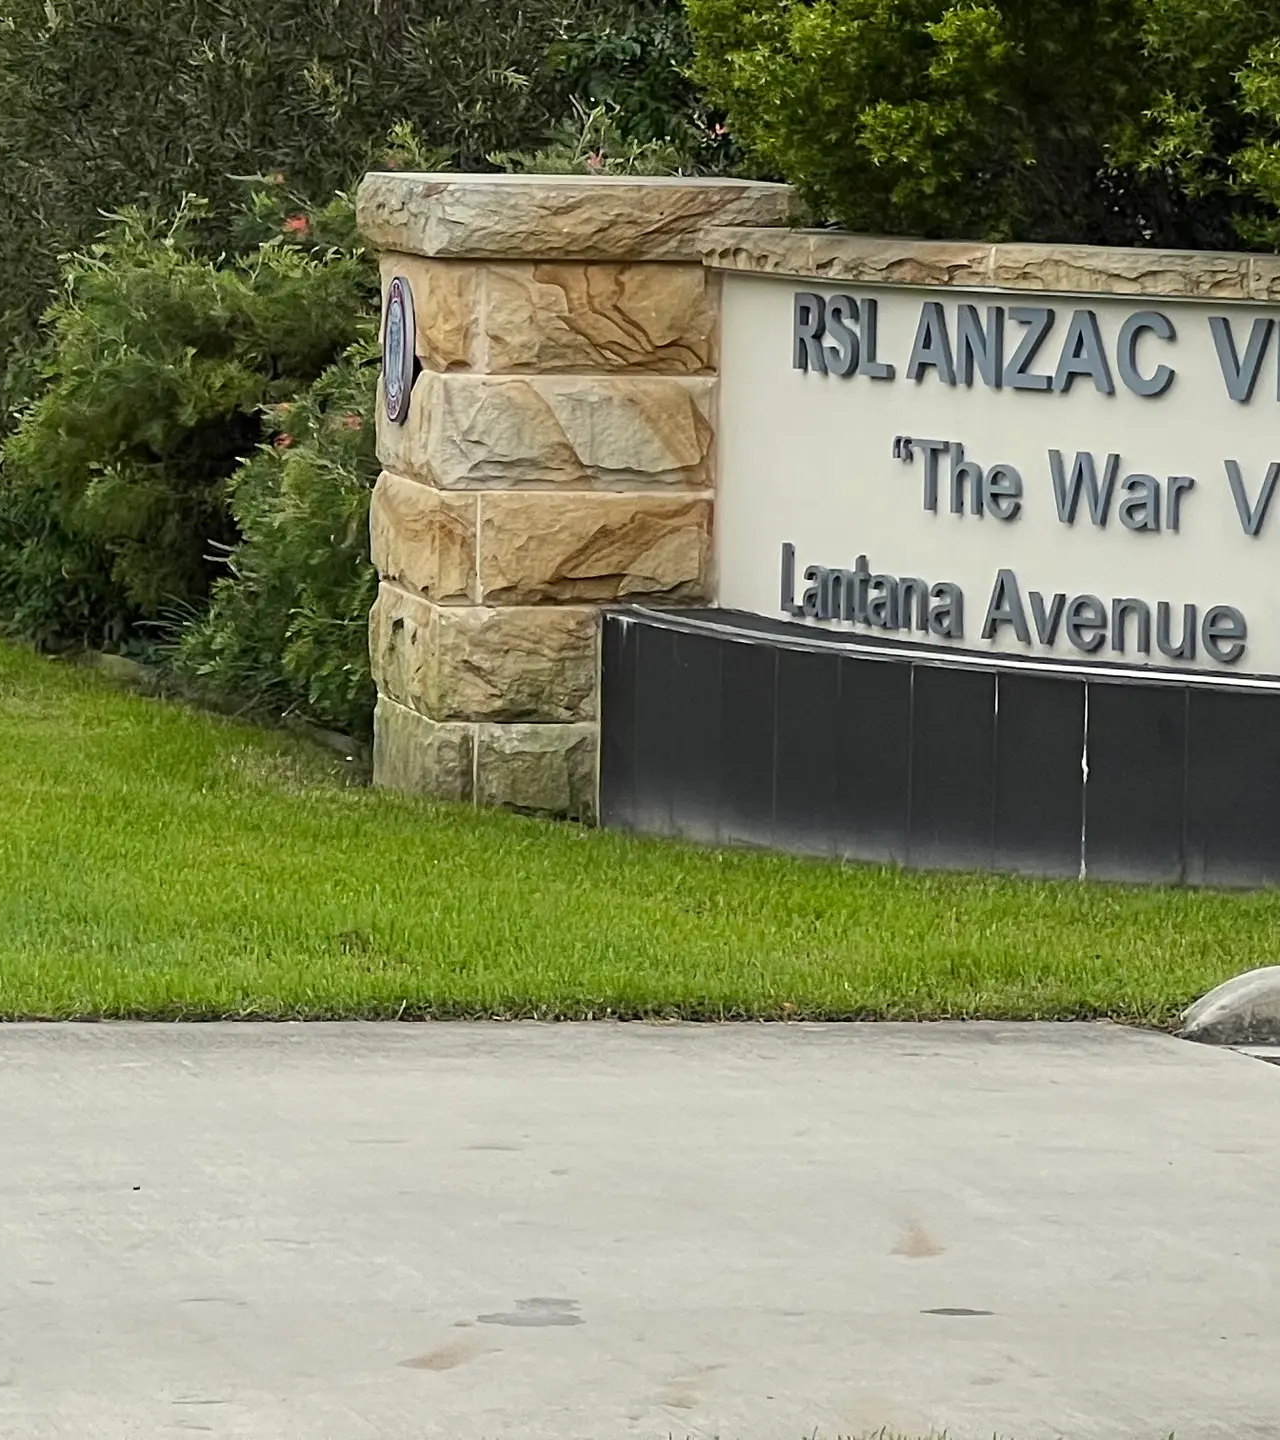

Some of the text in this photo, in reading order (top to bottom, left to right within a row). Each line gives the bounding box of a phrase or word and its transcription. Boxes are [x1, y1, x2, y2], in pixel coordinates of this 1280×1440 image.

[793, 292, 894, 379] RSL
[905, 302, 1177, 397] ANZAC
[1047, 449, 1195, 532] War
[780, 542, 964, 639] Lantana
[981, 569, 1247, 662] Avenue
